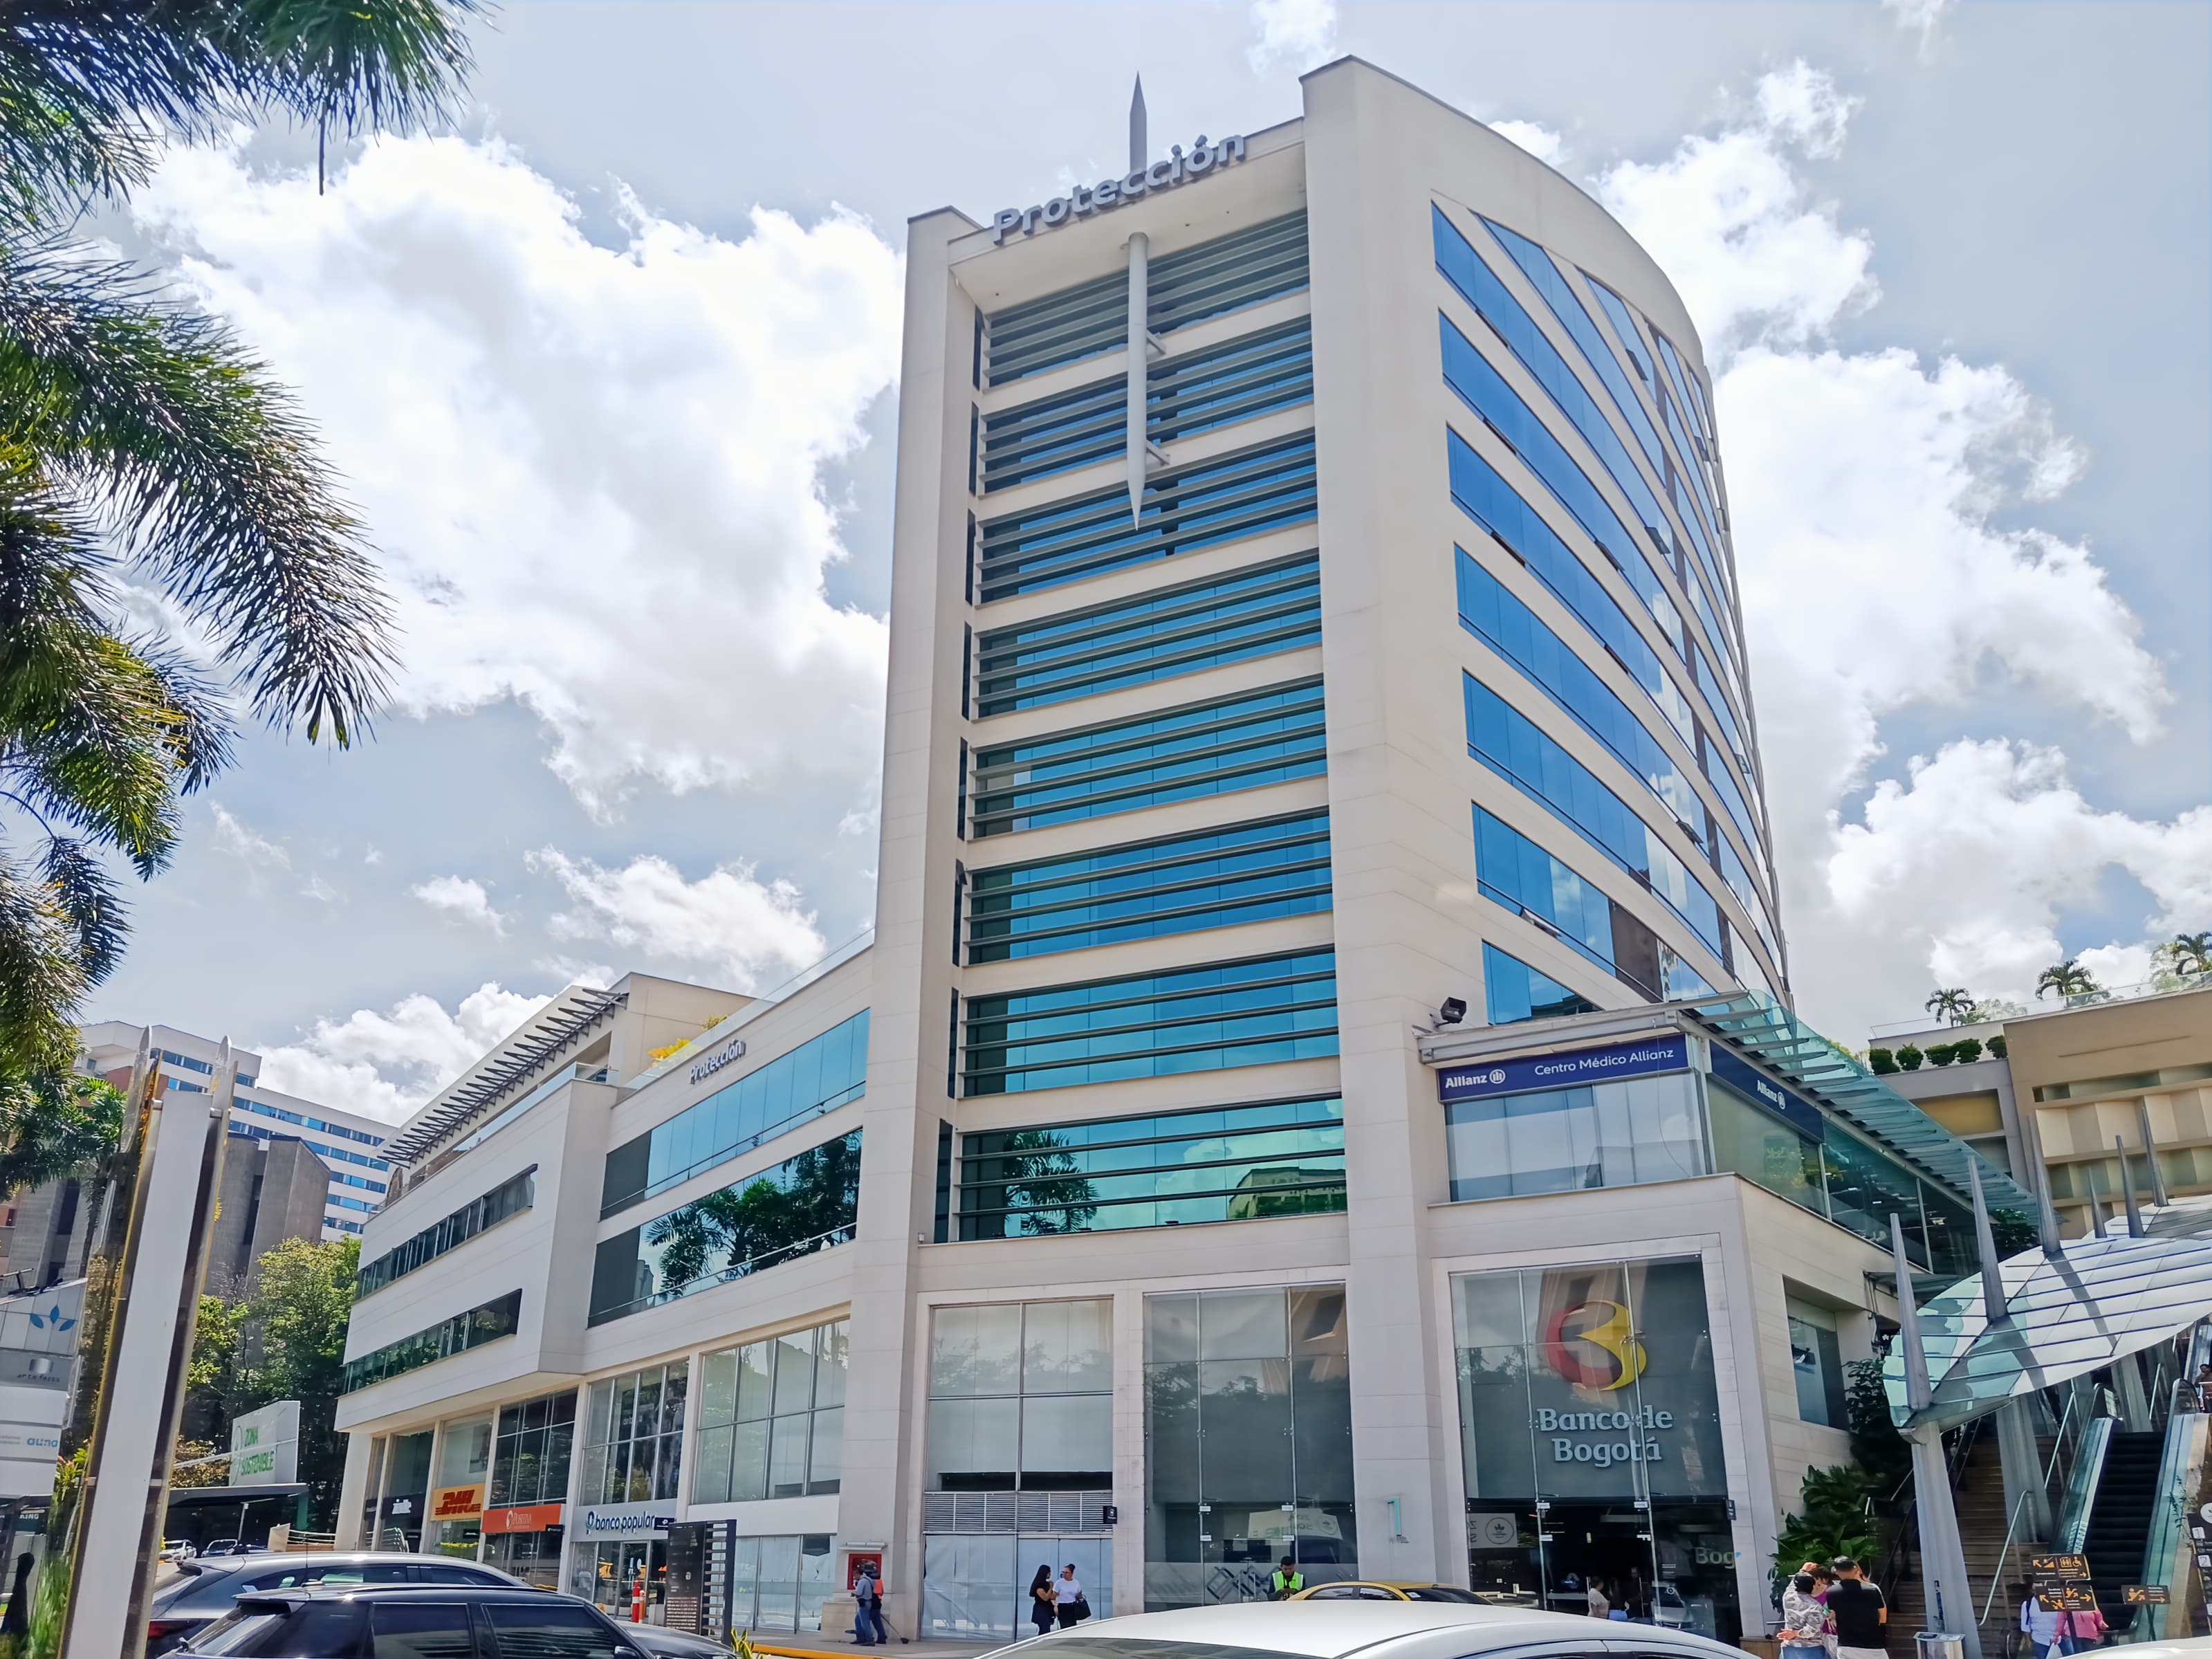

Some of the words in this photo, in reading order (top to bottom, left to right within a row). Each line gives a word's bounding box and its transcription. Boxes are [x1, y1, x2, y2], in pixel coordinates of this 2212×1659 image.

[992, 134, 1246, 246] Protección
[689, 1038, 746, 1085] Protección
[1534, 1062, 1576, 1076] Centro
[1579, 1054, 1627, 1070] Médico
[1629, 1048, 1675, 1063] Allianz
[1445, 1072, 1488, 1088] Allianz
[1757, 1079, 1778, 1103] Allianz
[1536, 1408, 1630, 1432] Banco
[1640, 1404, 1674, 1429] de
[1551, 1436, 1663, 1468] Bogotá
[596, 1514, 620, 1531] banco
[621, 1510, 656, 1534] popular
